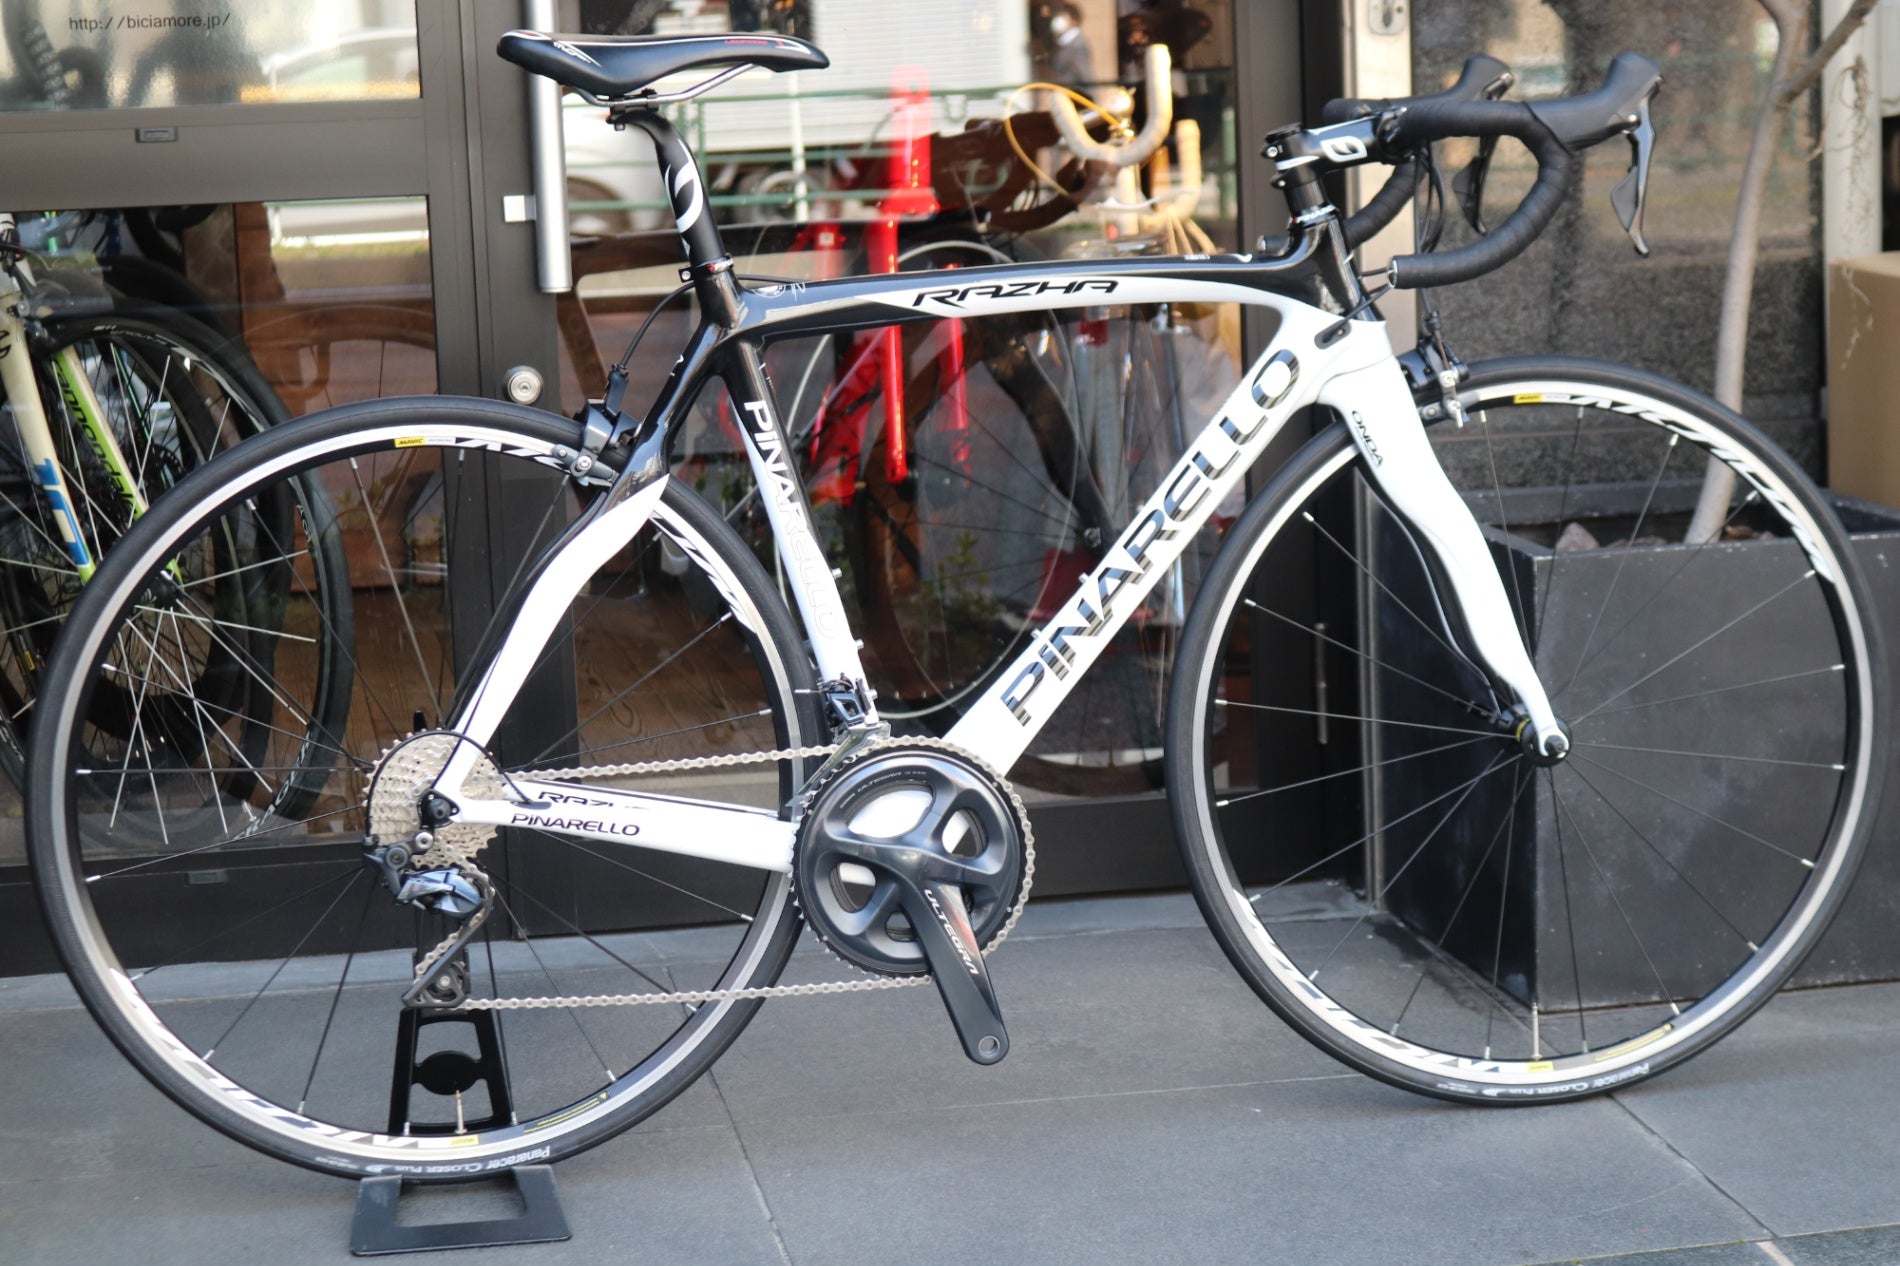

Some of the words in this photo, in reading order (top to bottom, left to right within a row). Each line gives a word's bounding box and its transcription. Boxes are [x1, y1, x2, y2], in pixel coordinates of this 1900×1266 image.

[912, 280, 1119, 309] RAZHA
[1352, 410, 1383, 467] ONDA
[1001, 349, 1300, 727] PINARELLO
[511, 813, 640, 836] PINARELLO
[924, 889, 979, 975] ULTEGRA
[486, 1145, 551, 1170] Panaracer
